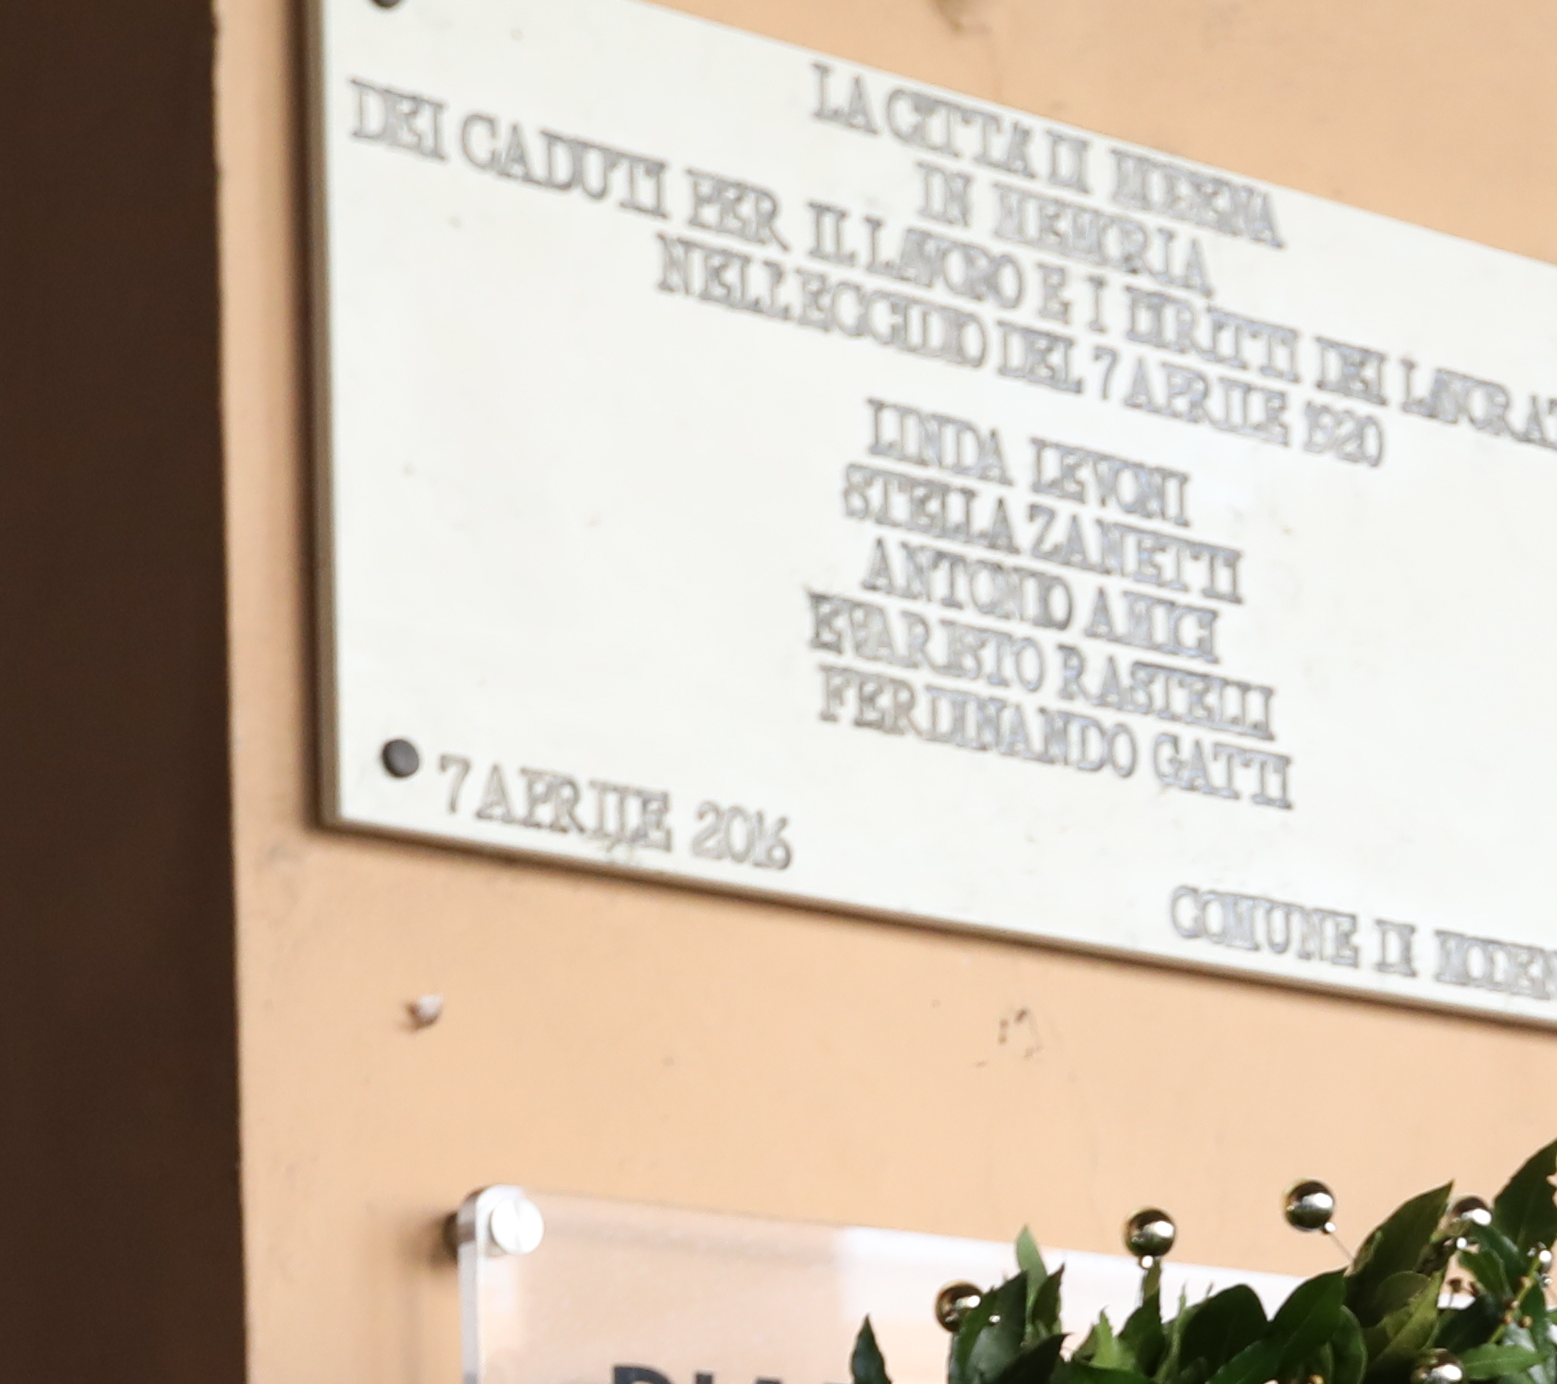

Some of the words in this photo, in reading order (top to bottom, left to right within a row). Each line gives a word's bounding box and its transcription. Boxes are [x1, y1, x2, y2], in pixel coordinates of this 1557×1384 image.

[812, 61, 879, 135] LA
[1046, 129, 1092, 195] DI
[1111, 148, 1286, 249] MODENA
[350, 77, 449, 163] DEI
[460, 112, 669, 220] CADUTI
[686, 167, 791, 252] PER
[808, 200, 856, 268] IL
[864, 216, 1025, 310] LAVORO
[1038, 262, 1072, 325] E
[1088, 274, 1109, 333] I
[1124, 285, 1303, 385] DIRITTI
[1314, 336, 1389, 406] DEI
[916, 161, 973, 227] IN
[992, 181, 1215, 299] MEMORIA
[865, 397, 1014, 487] LINDA
[997, 320, 1084, 394] DEL
[1093, 346, 1121, 401] 7
[1123, 356, 1291, 447] APRILE
[1303, 400, 1386, 469] 1920
[843, 462, 1021, 555] STELLA
[1028, 502, 1245, 605] ZANETTI
[860, 536, 1075, 631] ANTONIO
[1083, 586, 1221, 665] AMICI
[806, 588, 1046, 693] EVARISTO
[1056, 643, 1277, 742] RASTELLI
[818, 664, 1140, 780] FERDINANDO
[1152, 732, 1295, 811] GATTI
[439, 753, 472, 815] 7
[475, 763, 674, 854] APRILE
[690, 799, 794, 872] 2016
[1169, 883, 1360, 969] COMUNE
[1374, 917, 1418, 978] DI
